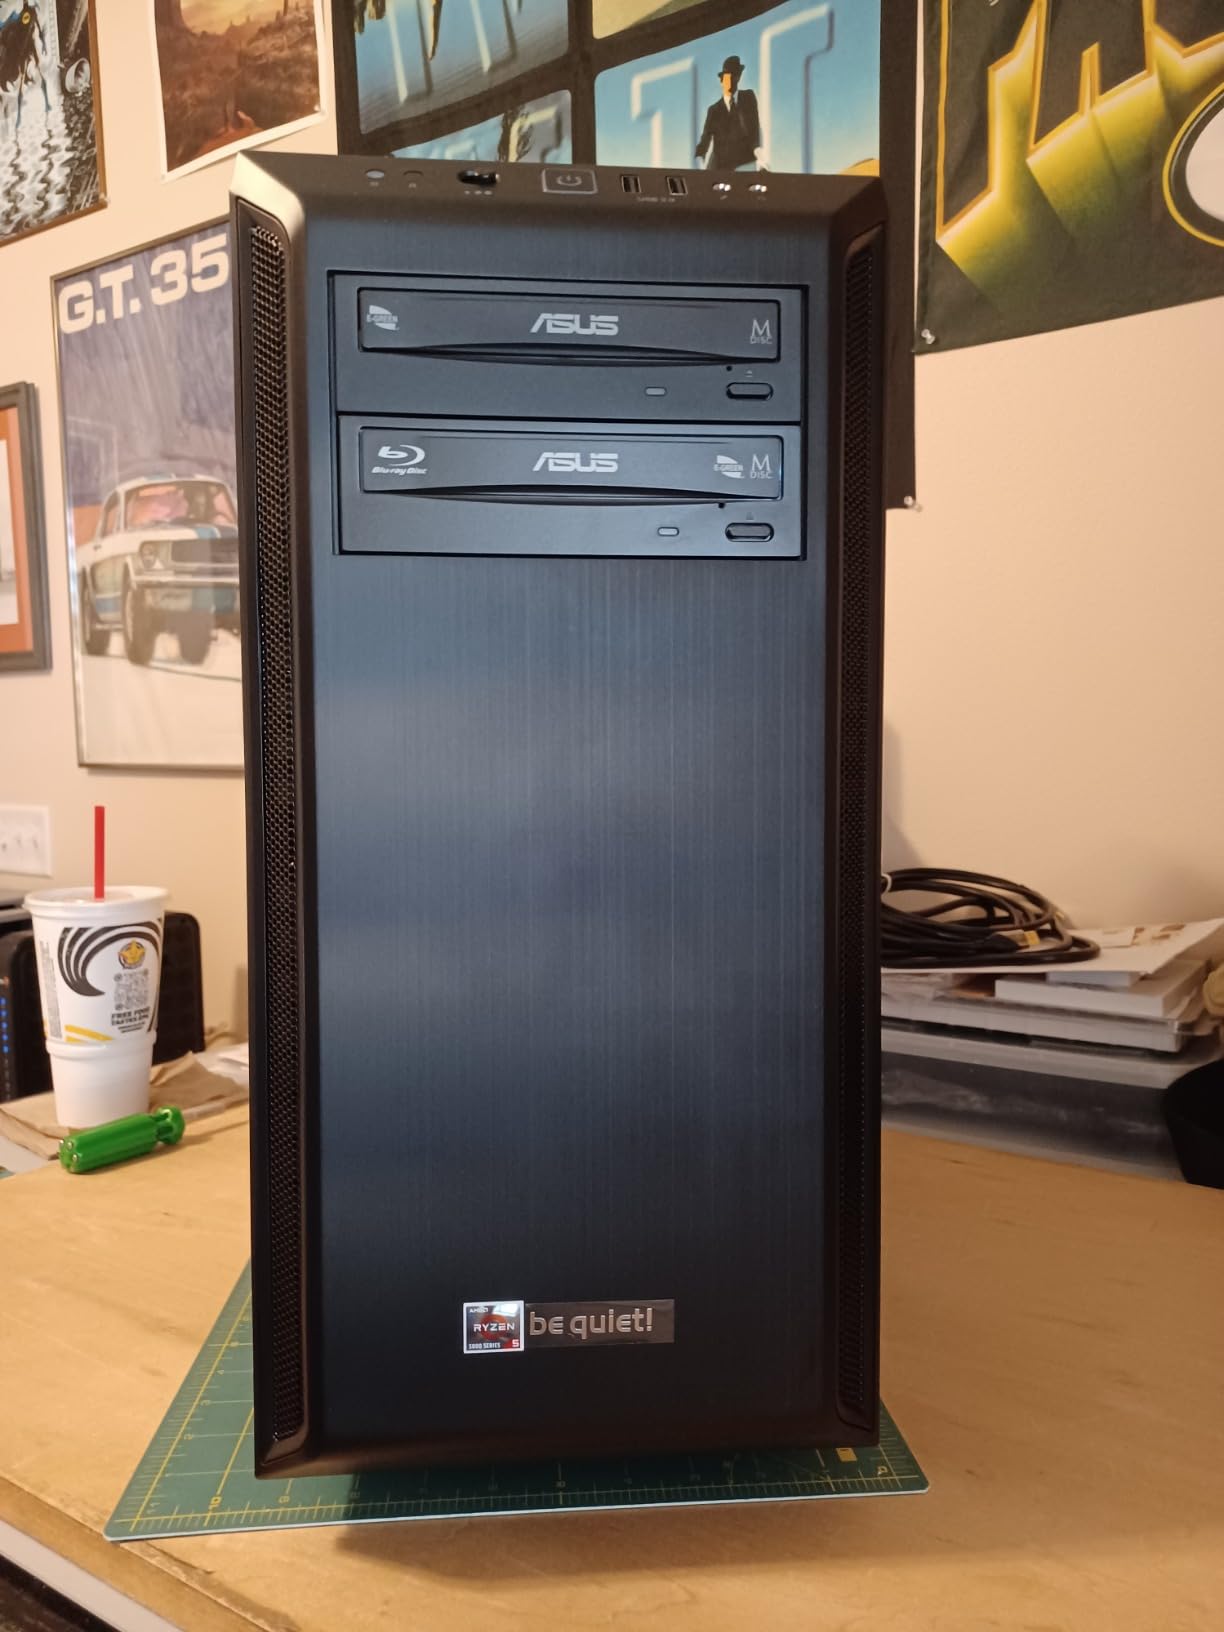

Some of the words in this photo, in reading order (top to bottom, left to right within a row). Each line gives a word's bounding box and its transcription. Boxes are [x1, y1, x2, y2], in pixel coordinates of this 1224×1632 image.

[58, 264, 141, 334] G.T.
[530, 312, 619, 336] ASUS
[532, 451, 619, 473] ASUS
[473, 1322, 515, 1332] RYZEN
[529, 1311, 564, 1336] be
[569, 1307, 654, 1340] quiet!
